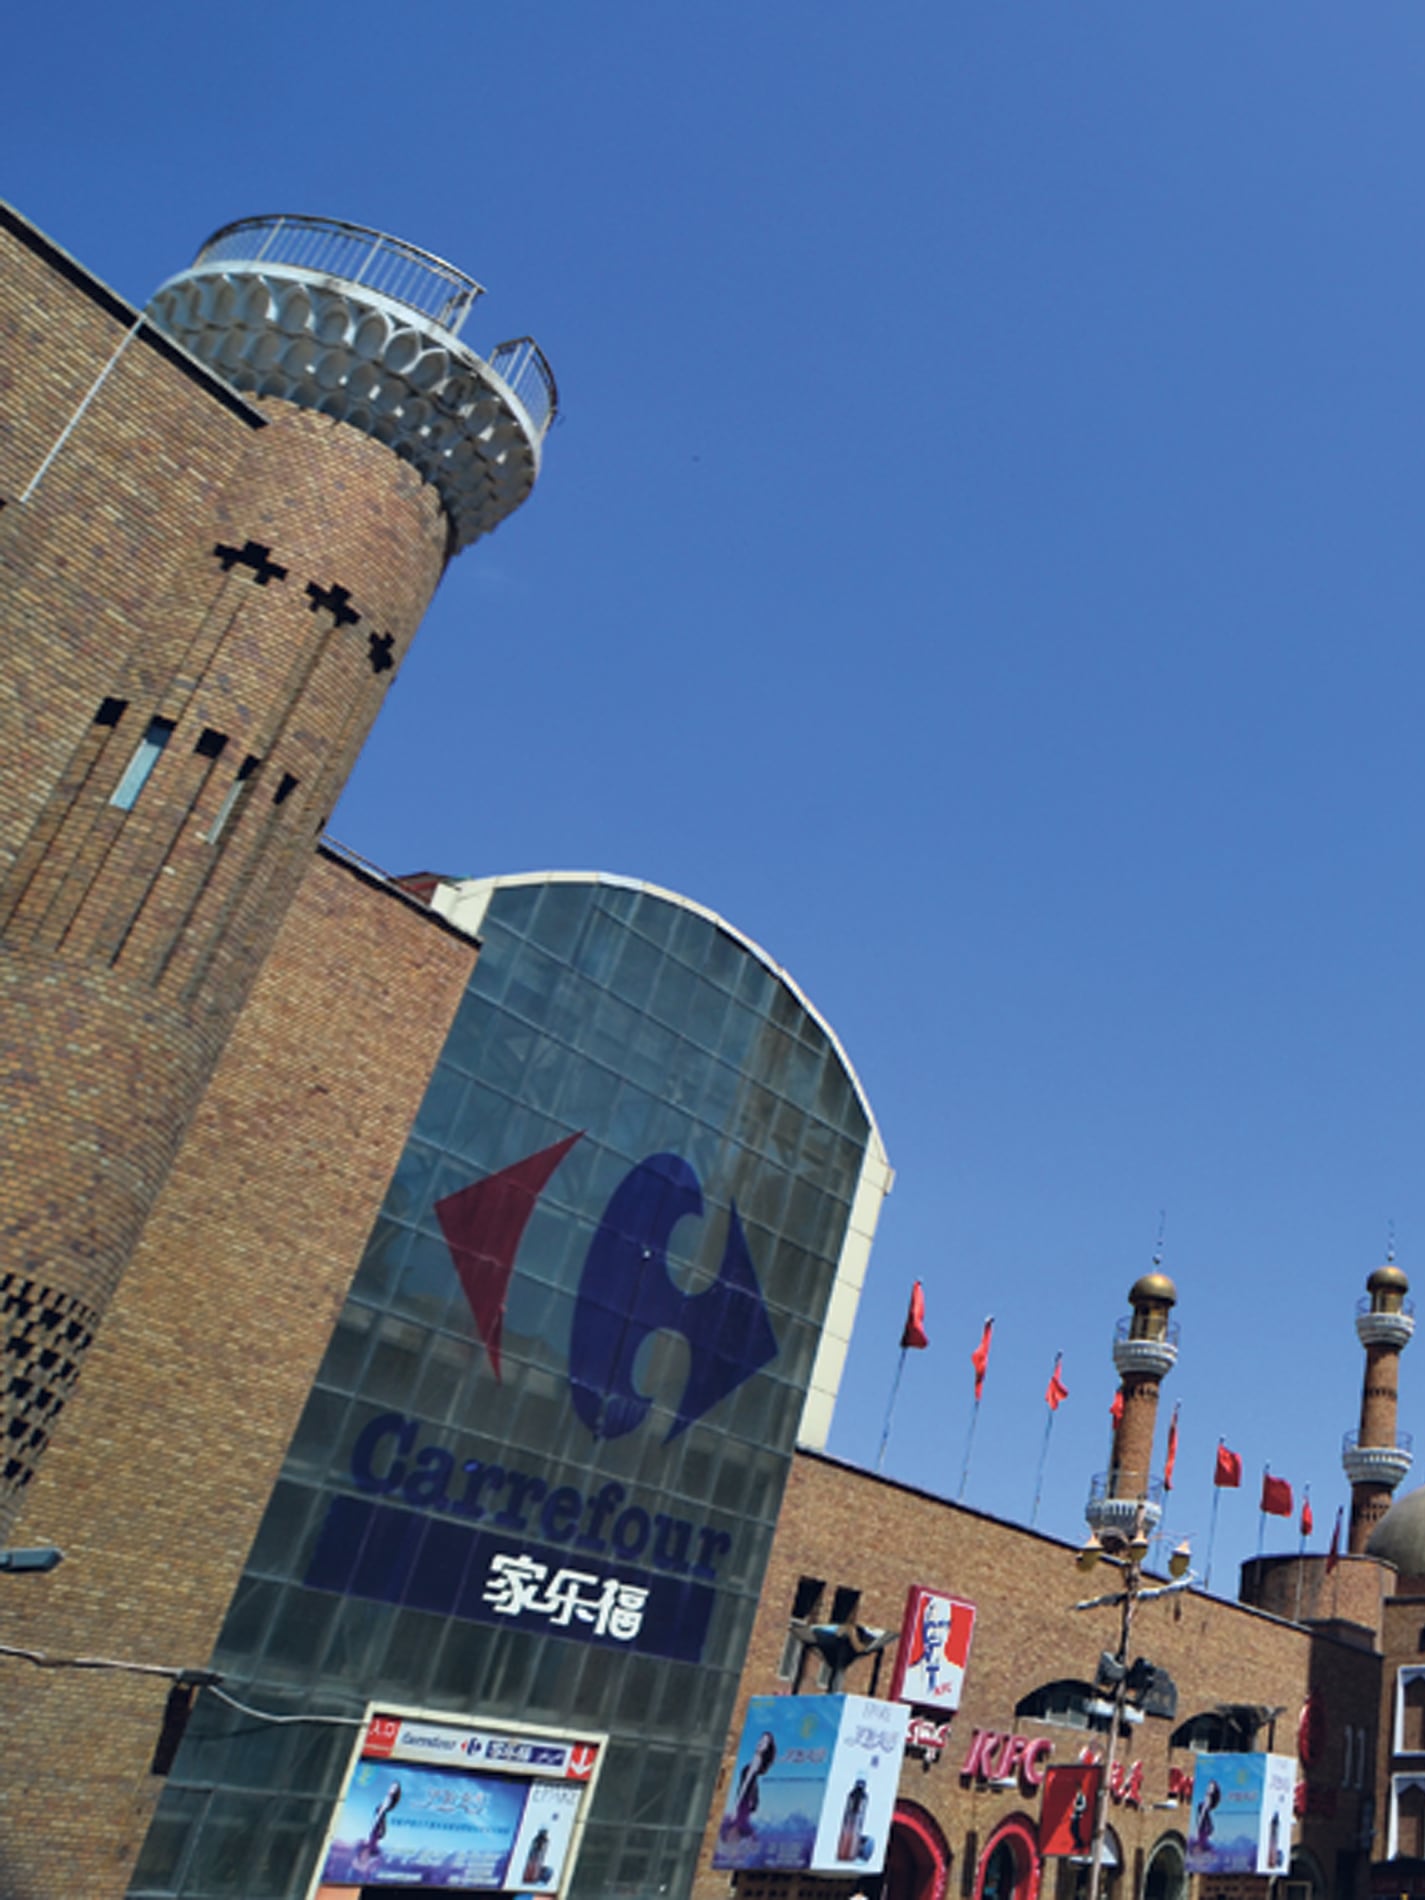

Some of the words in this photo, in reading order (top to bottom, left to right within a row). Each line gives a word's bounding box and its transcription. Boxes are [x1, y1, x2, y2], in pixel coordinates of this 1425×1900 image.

[350, 1412, 732, 1580] Carrefour
[482, 1554, 650, 1640] 家乐福
[961, 1728, 1053, 1784] KFC
